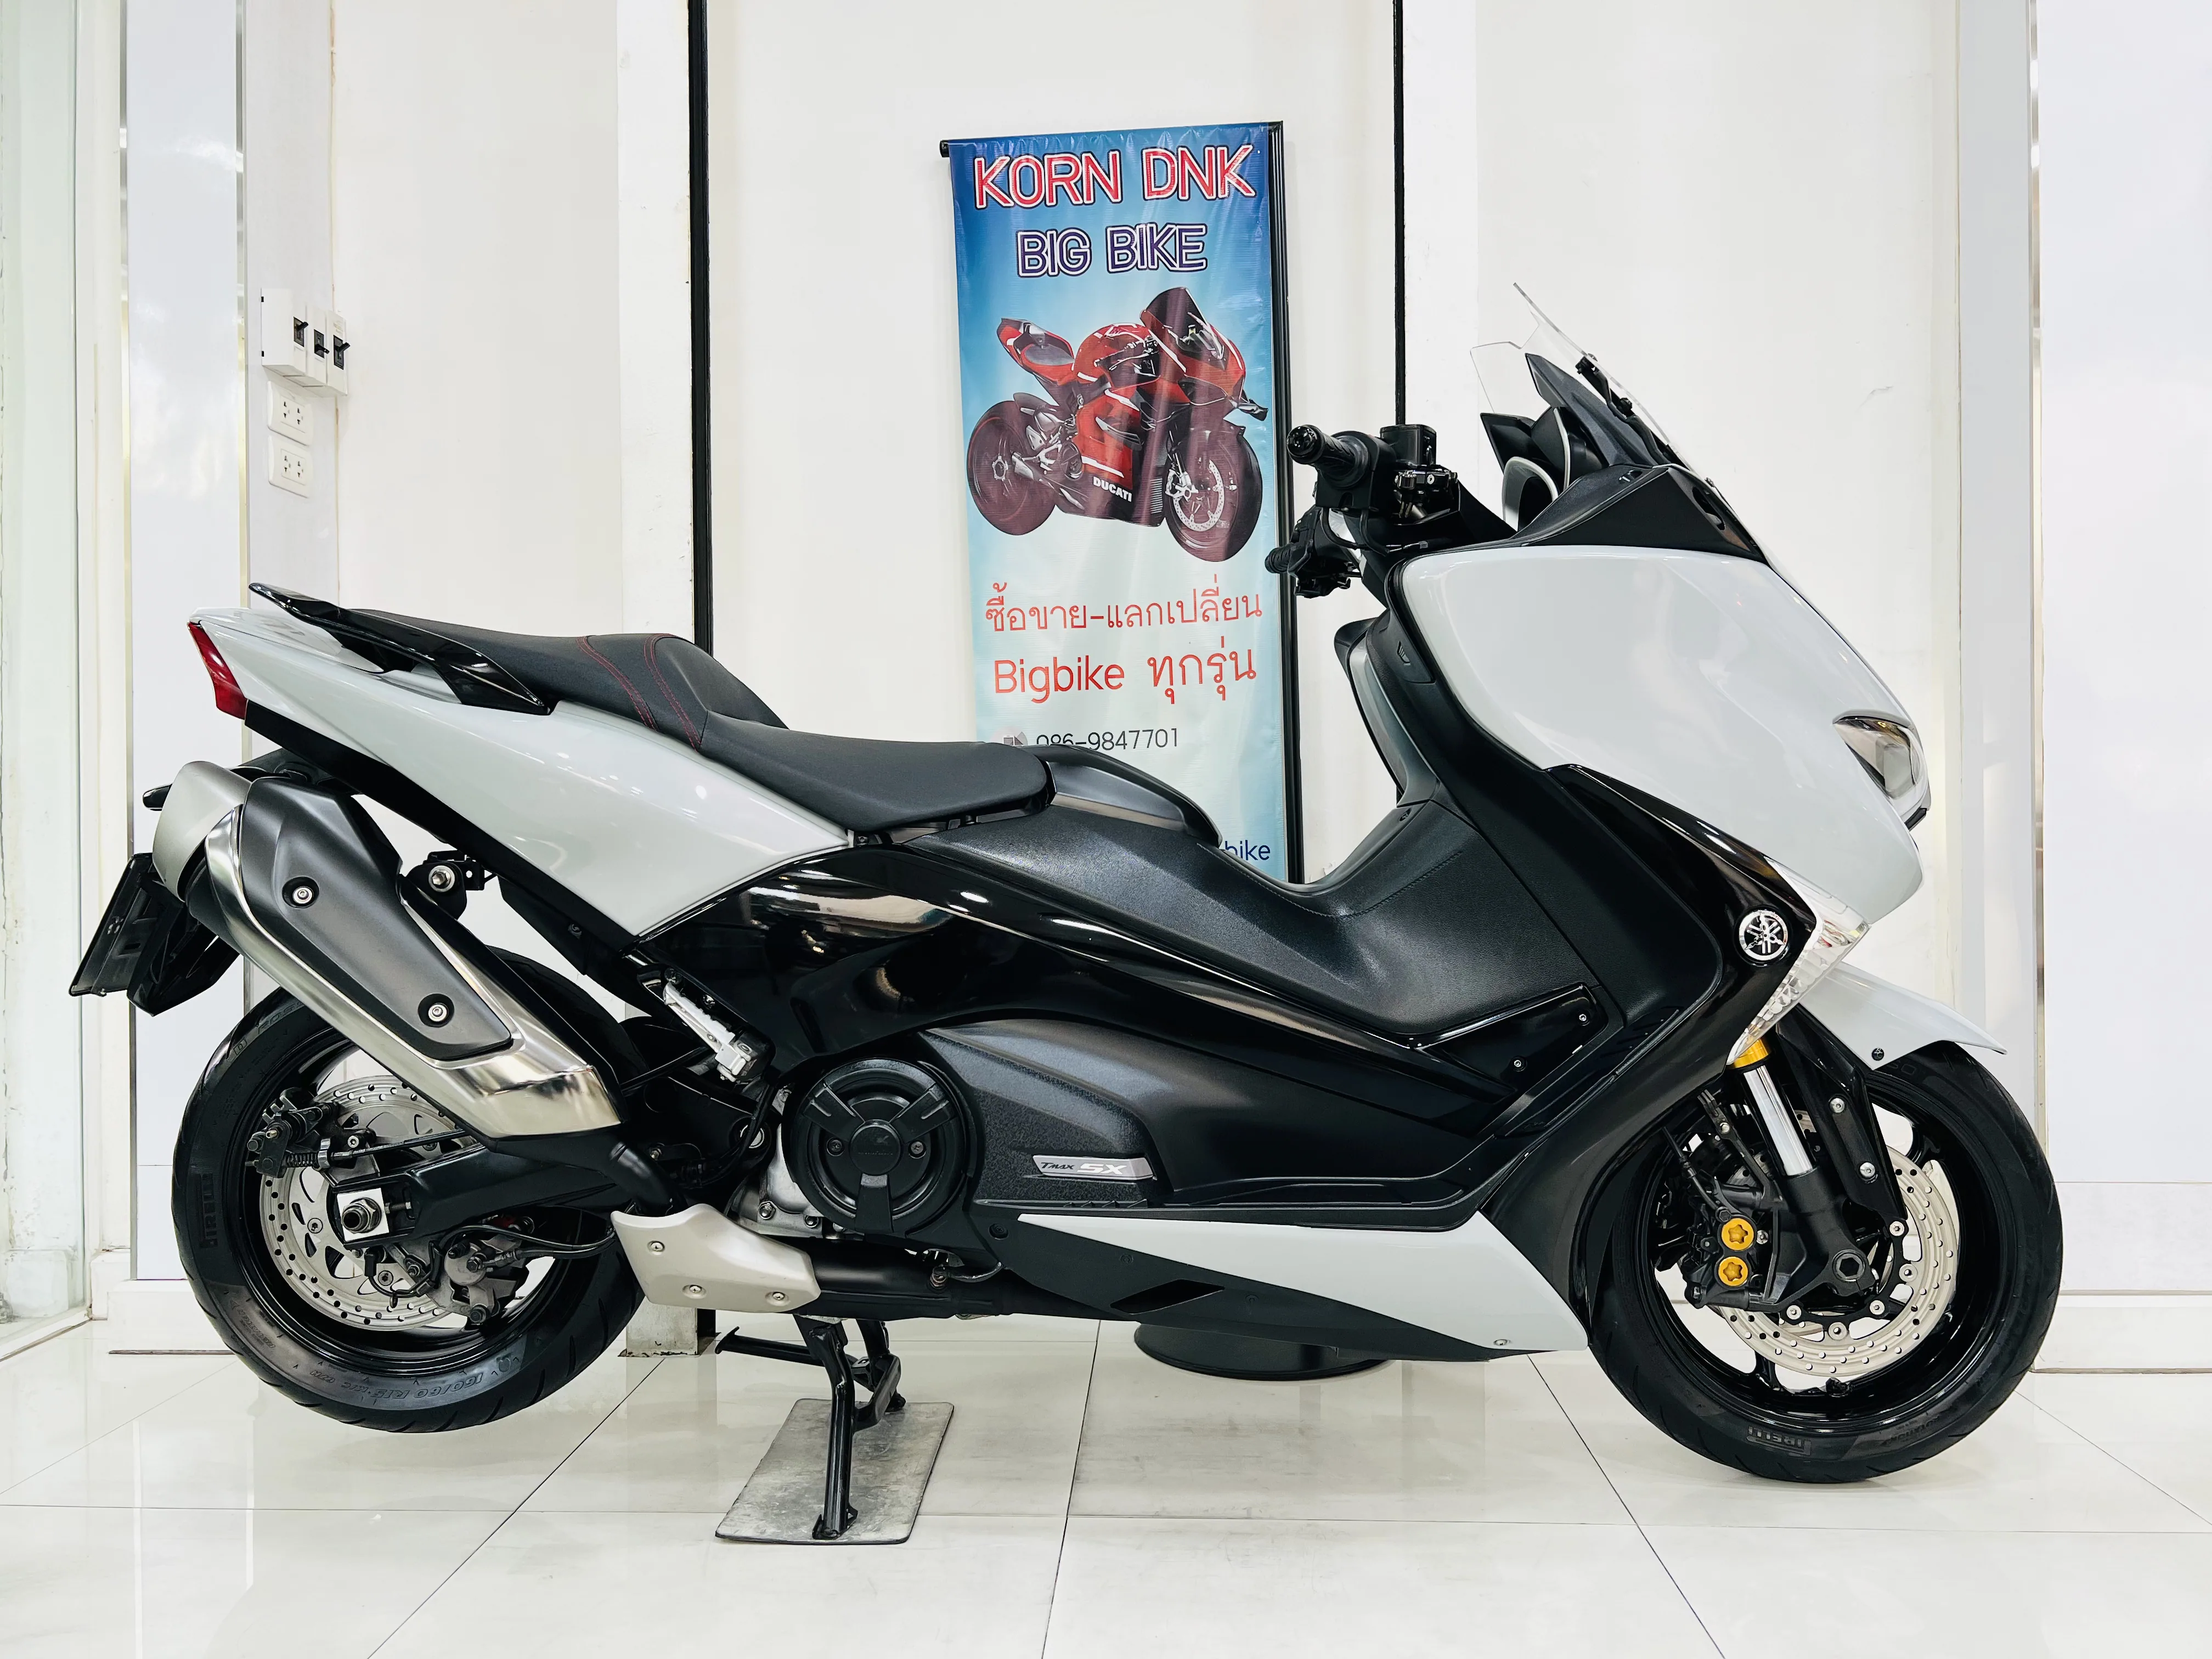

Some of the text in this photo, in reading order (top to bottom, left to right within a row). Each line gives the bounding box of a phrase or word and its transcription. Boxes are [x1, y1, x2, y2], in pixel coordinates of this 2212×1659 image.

[974, 144, 1256, 210] KORN DNK
[1017, 222, 1207, 278] BIG BIKE
[1093, 476, 1132, 503] DUCATI
[986, 574, 1262, 631] ซื้อขาย-แลกเปลี่ยน
[995, 636, 1256, 704] Bigbike ทุกรุ่น
[1077, 1163, 1127, 1175] SX
[1746, 1425, 1812, 1457] PIRELLI
